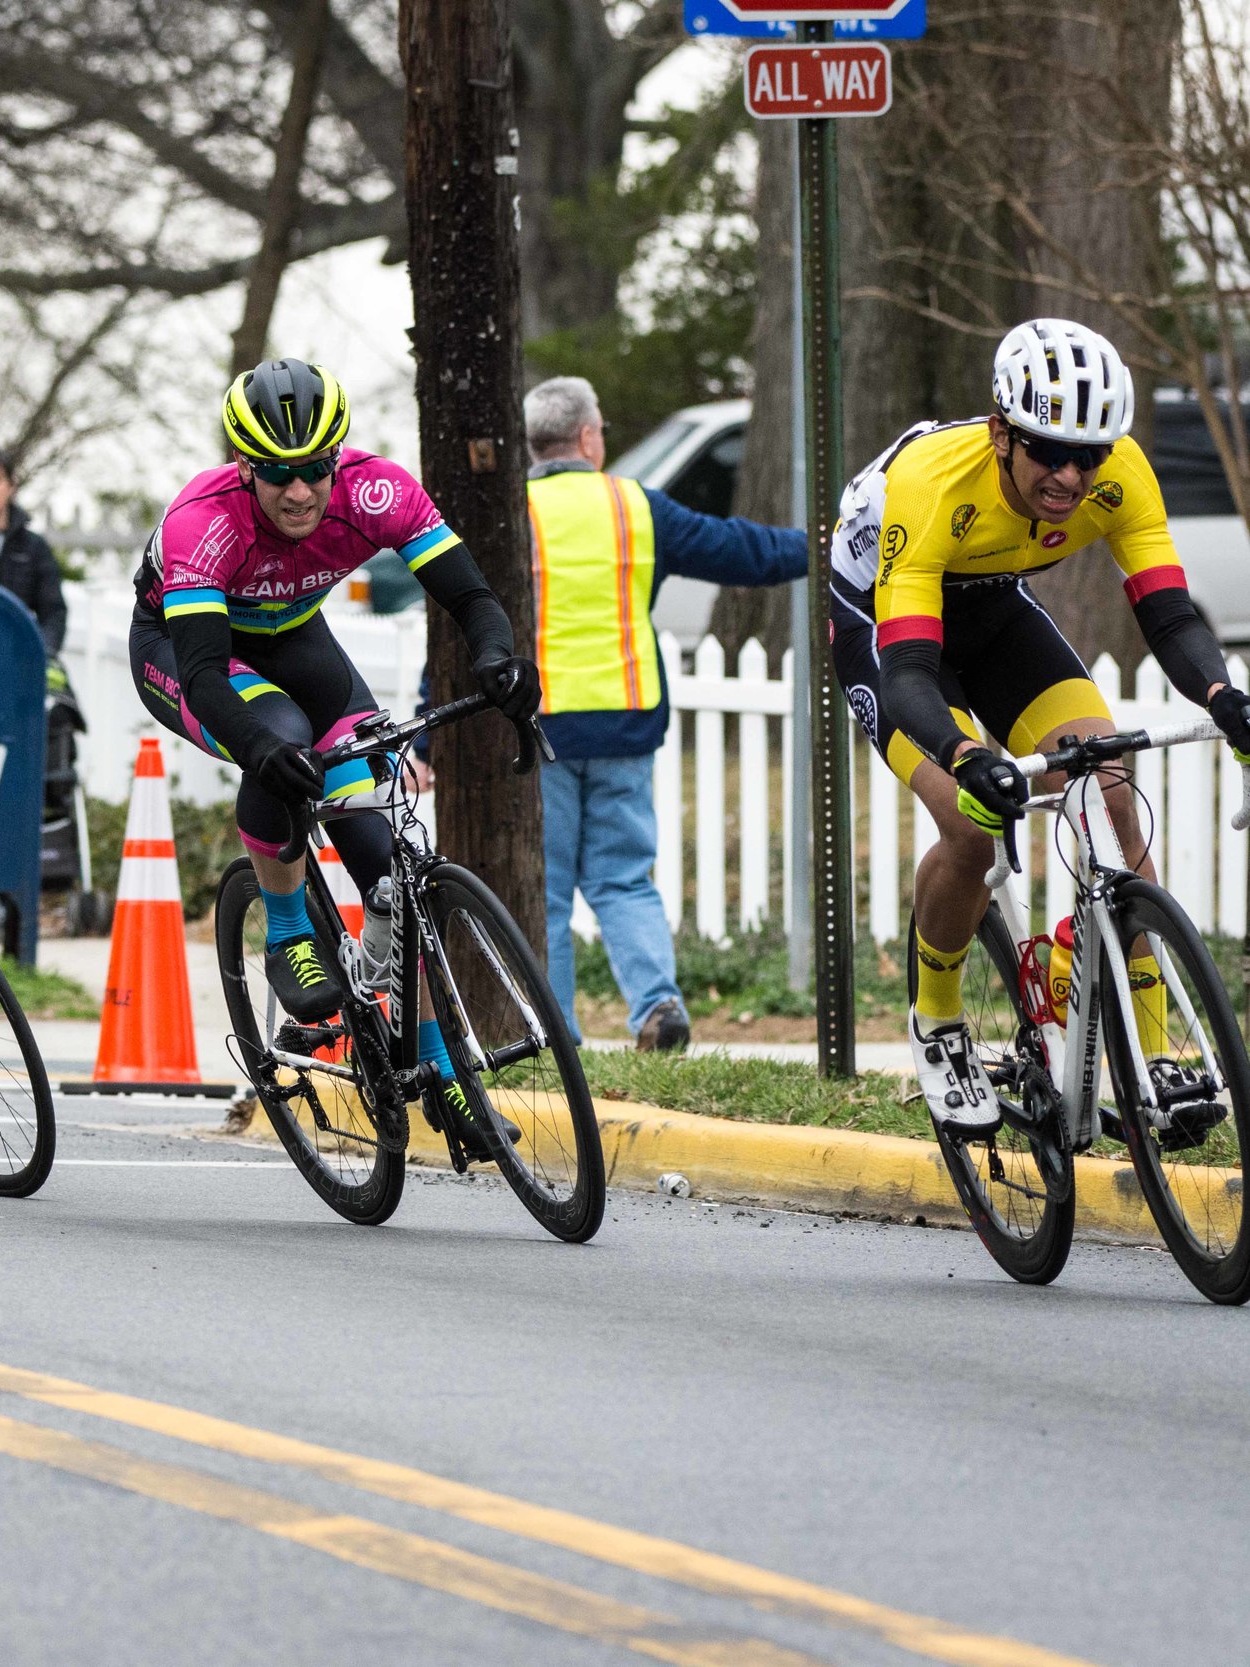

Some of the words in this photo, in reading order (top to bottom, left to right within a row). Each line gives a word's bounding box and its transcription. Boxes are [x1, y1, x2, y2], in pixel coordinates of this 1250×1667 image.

[754, 62, 808, 102] ALL
[821, 59, 881, 100] WAY
[226, 402, 238, 427] GIRO
[351, 477, 364, 515] GUNNAR
[390, 479, 403, 516] CYCLES
[885, 530, 899, 555] DT
[301, 567, 351, 590] BBC
[144, 661, 165, 690] TEAM
[164, 675, 181, 699] BBC
[852, 691, 875, 731] DISTRICT
[389, 855, 404, 1039] cannondale
